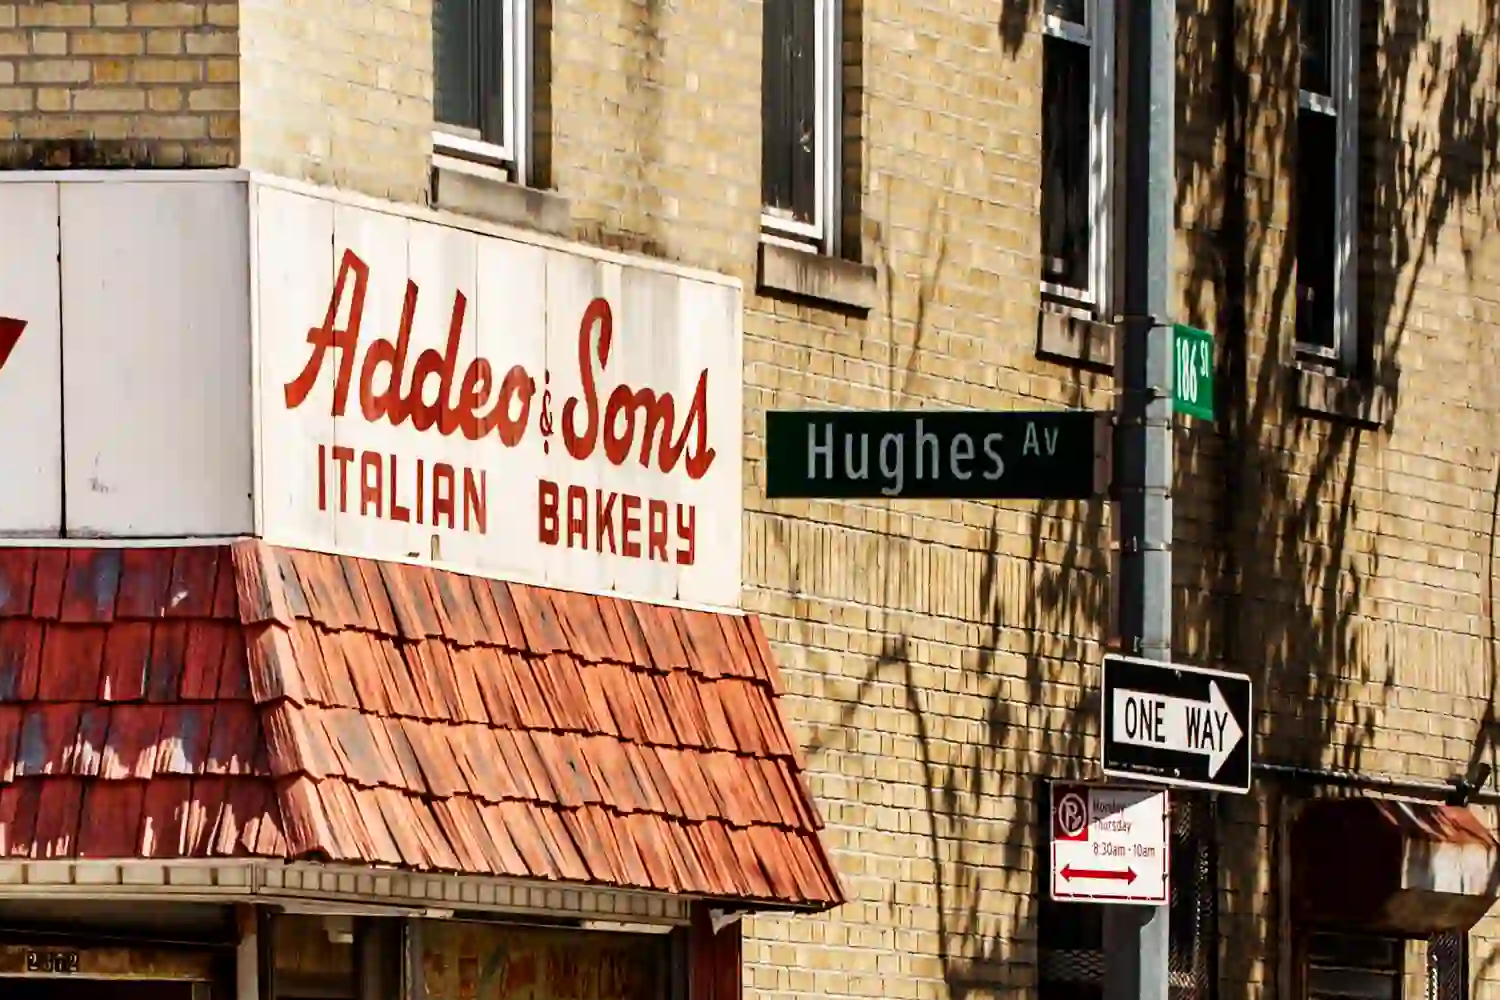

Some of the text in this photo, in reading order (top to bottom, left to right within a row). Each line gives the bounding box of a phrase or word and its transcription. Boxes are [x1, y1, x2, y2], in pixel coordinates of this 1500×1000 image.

[284, 248, 716, 480] Addeo & Sons
[1176, 337, 1198, 404] 186
[806, 419, 1060, 497] Hughes Av
[318, 444, 696, 566] ITALIAN BAKERY
[1124, 696, 1229, 753] ONE WAY
